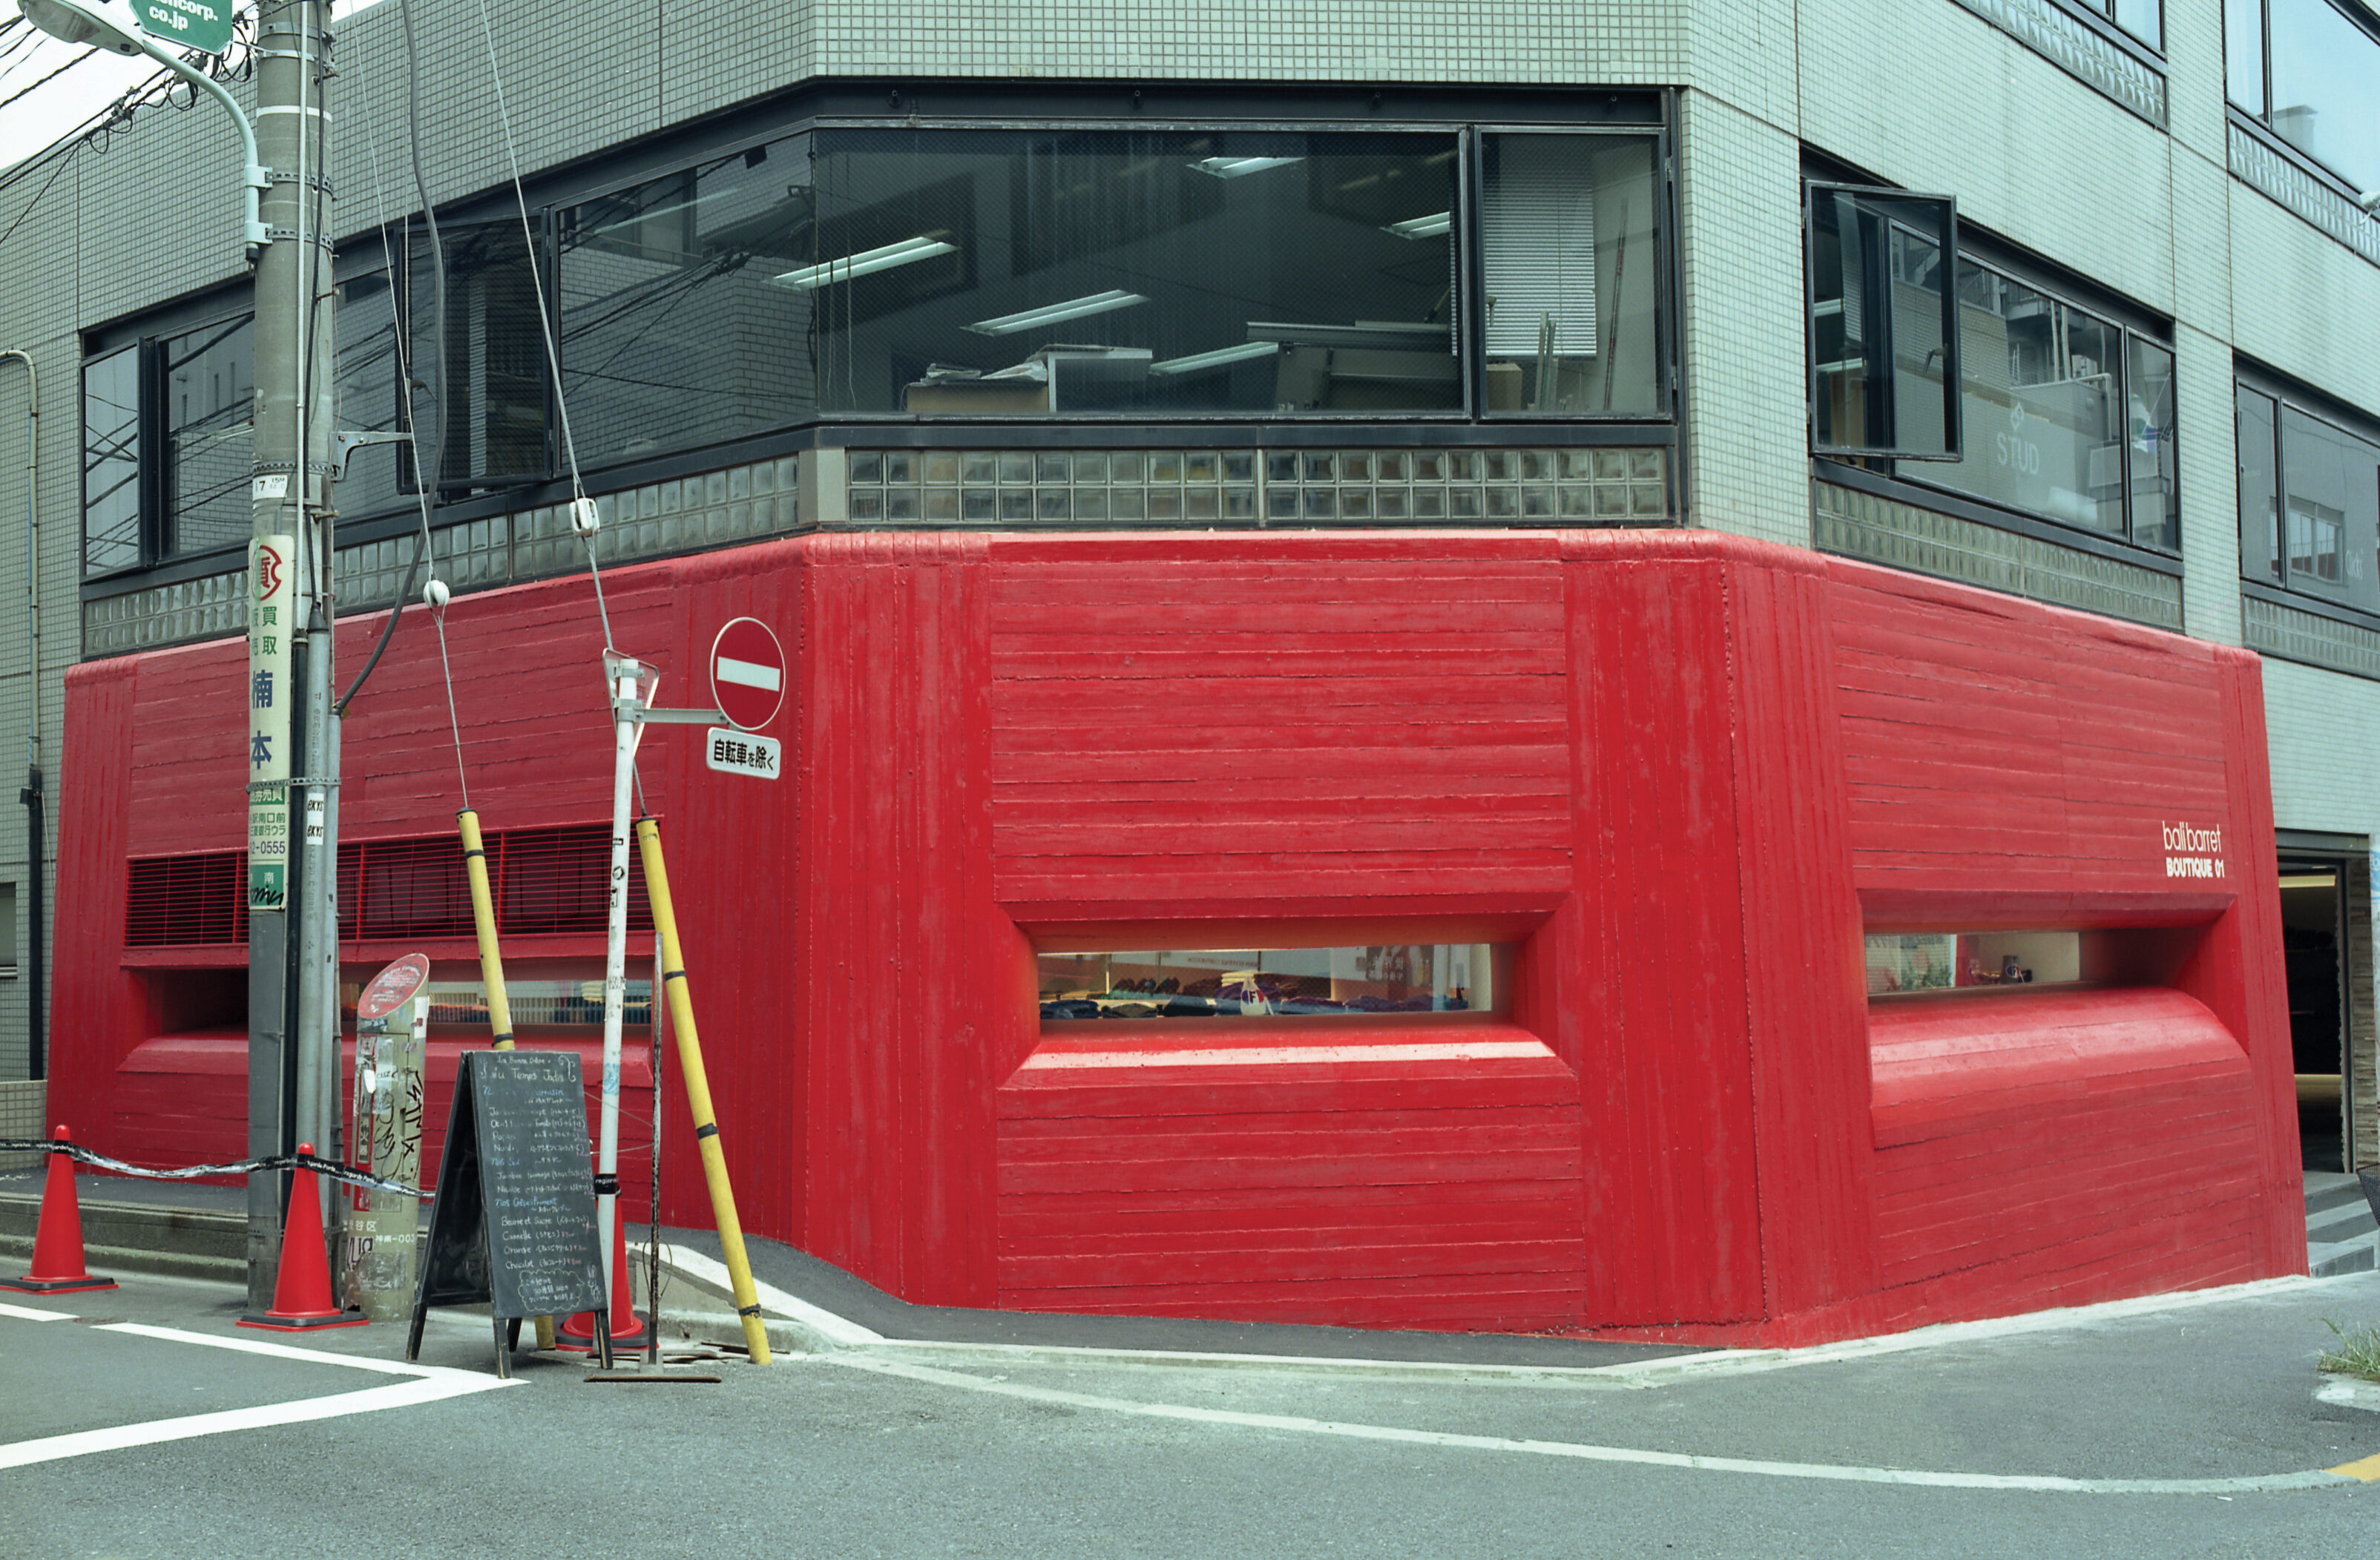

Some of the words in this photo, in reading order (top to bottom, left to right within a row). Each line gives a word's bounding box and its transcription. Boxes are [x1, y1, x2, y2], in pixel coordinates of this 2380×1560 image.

[148, 6, 188, 30] co.jp
[154, 0, 218, 21] ncorp.
[1996, 432, 2039, 475] STUD
[262, 606, 277, 655] 買取
[252, 669, 274, 770] 楠本
[714, 739, 774, 771] 自転車を除く
[2166, 857, 2213, 878] BOUTIQUE
[2215, 858, 2225, 878] 01
